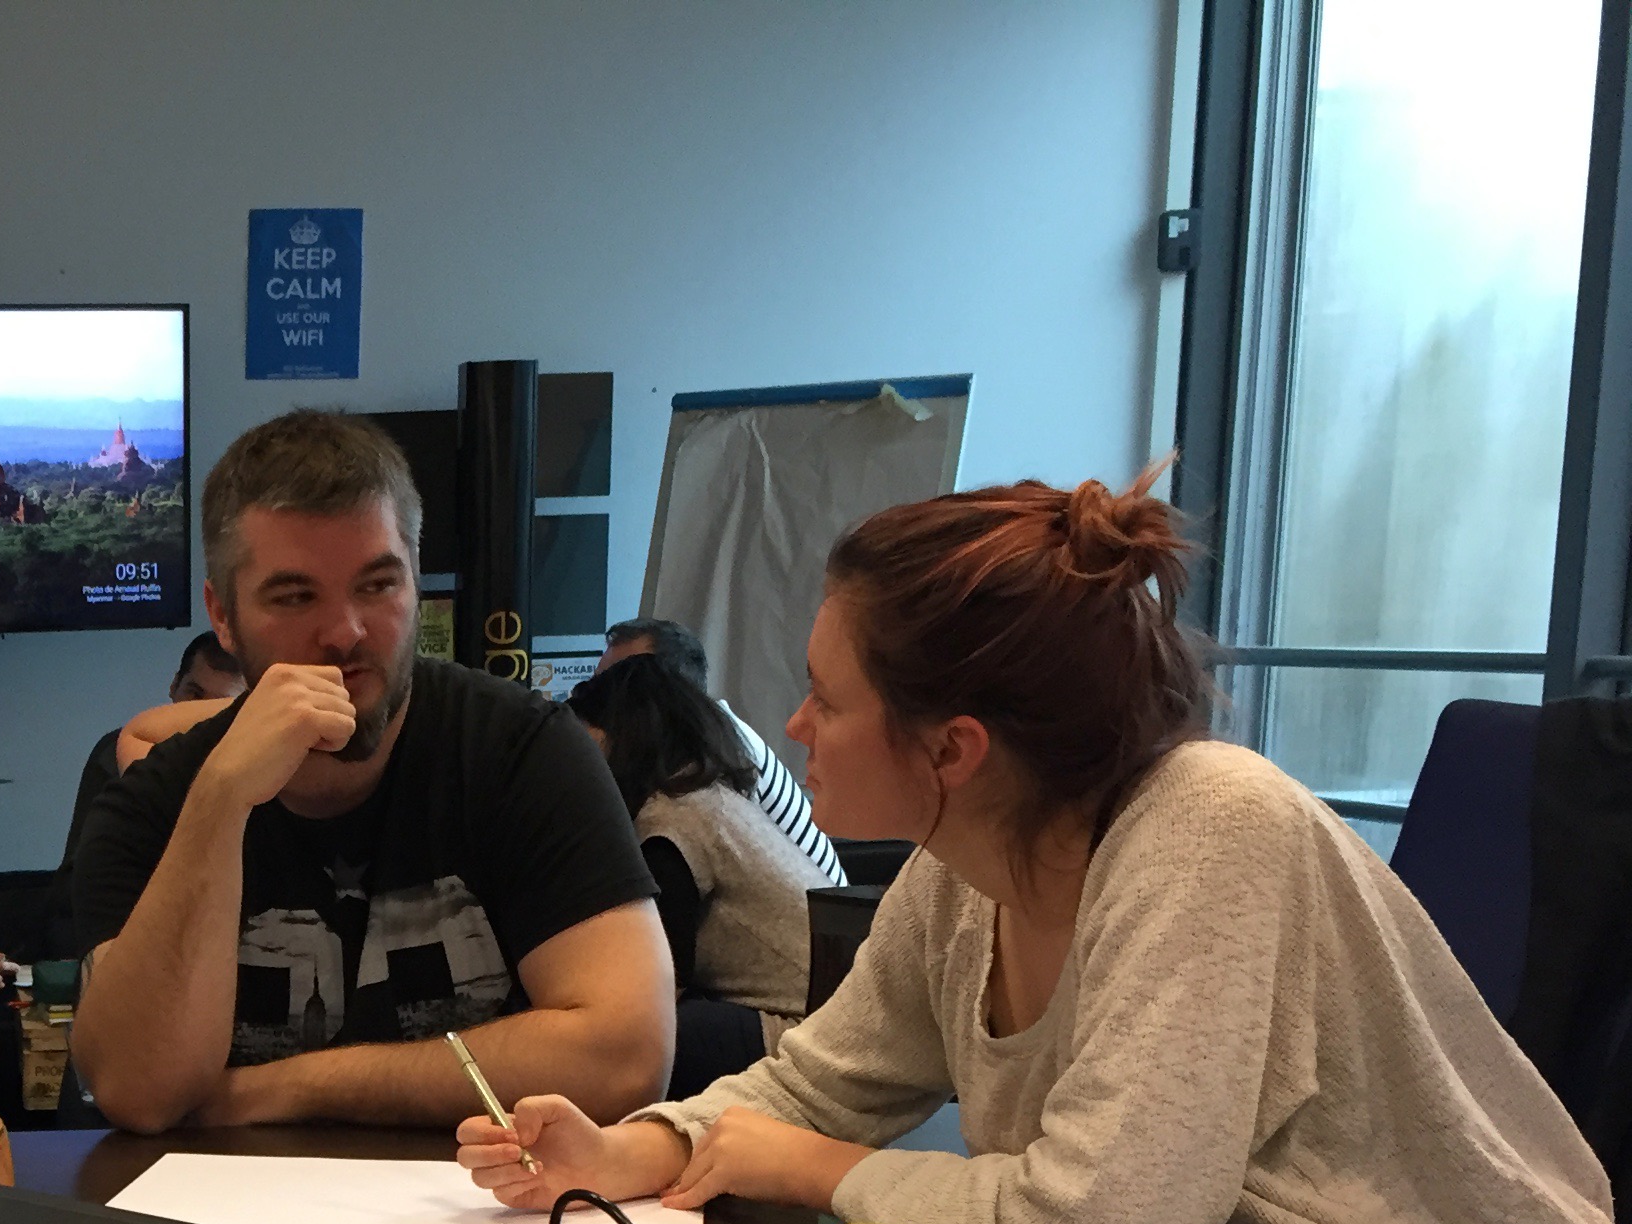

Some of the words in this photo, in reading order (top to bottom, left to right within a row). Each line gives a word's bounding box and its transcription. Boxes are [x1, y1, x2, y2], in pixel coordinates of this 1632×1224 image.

[274, 247, 337, 270] KEEP
[266, 277, 342, 300] CALM
[276, 312, 299, 325] USE
[303, 312, 330, 324] OUR
[282, 328, 324, 347] WIFI
[115, 562, 159, 581] 09:51
